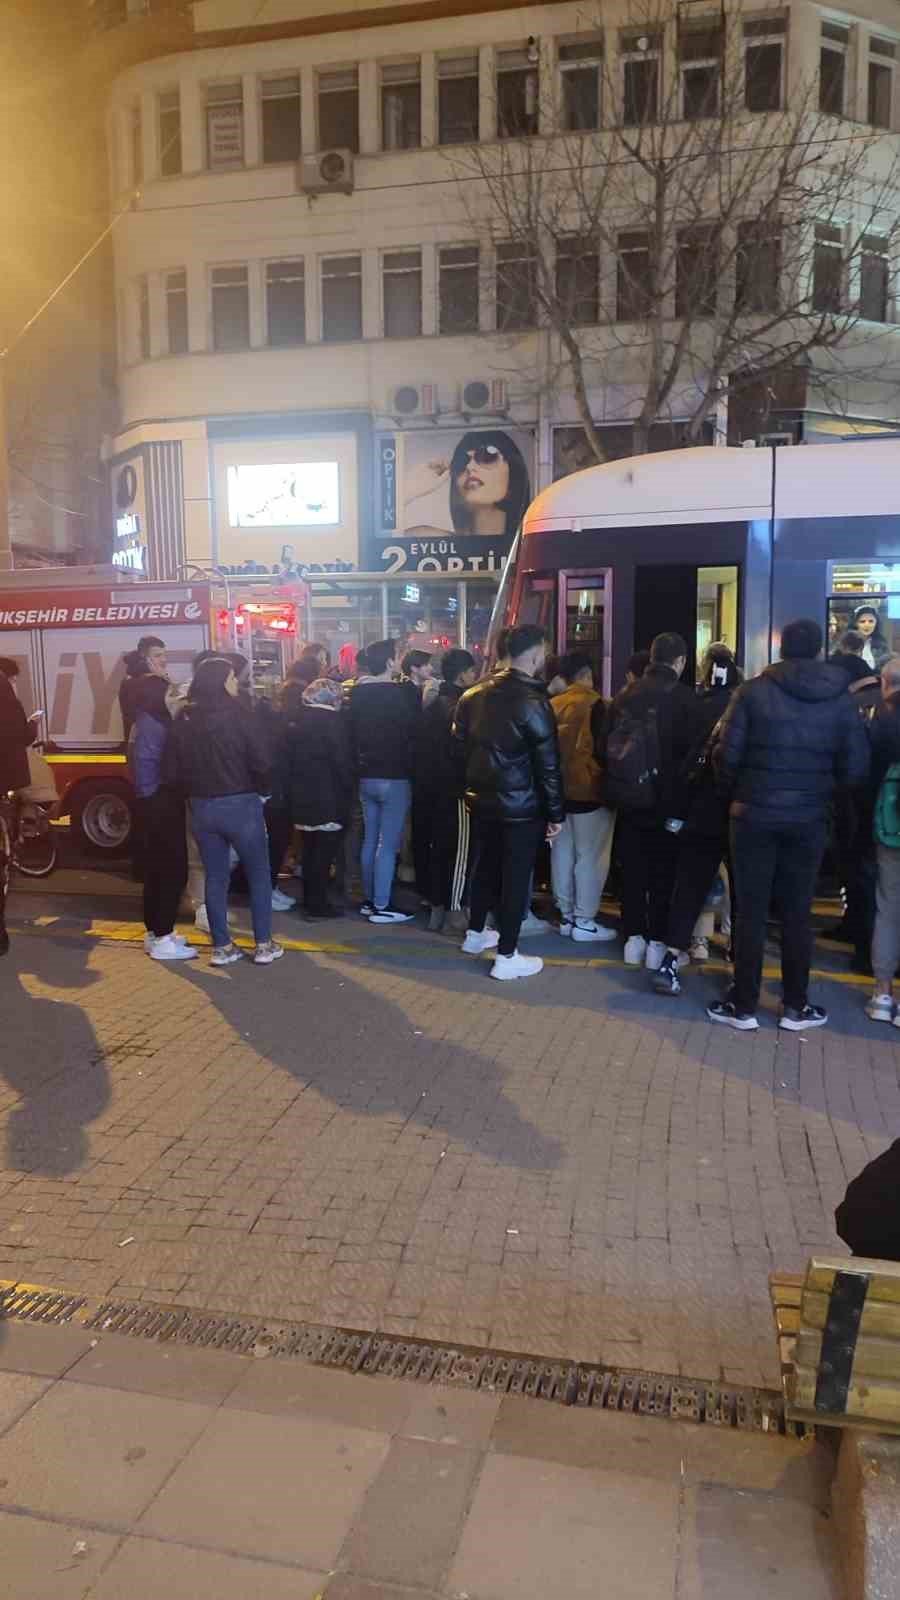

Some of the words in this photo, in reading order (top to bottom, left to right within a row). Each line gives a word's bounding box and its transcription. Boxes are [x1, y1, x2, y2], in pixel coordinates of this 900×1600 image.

[381, 546, 407, 574] 2
[411, 540, 457, 554] EYLÜL
[72, 603, 178, 621] BELEDİYESİ
